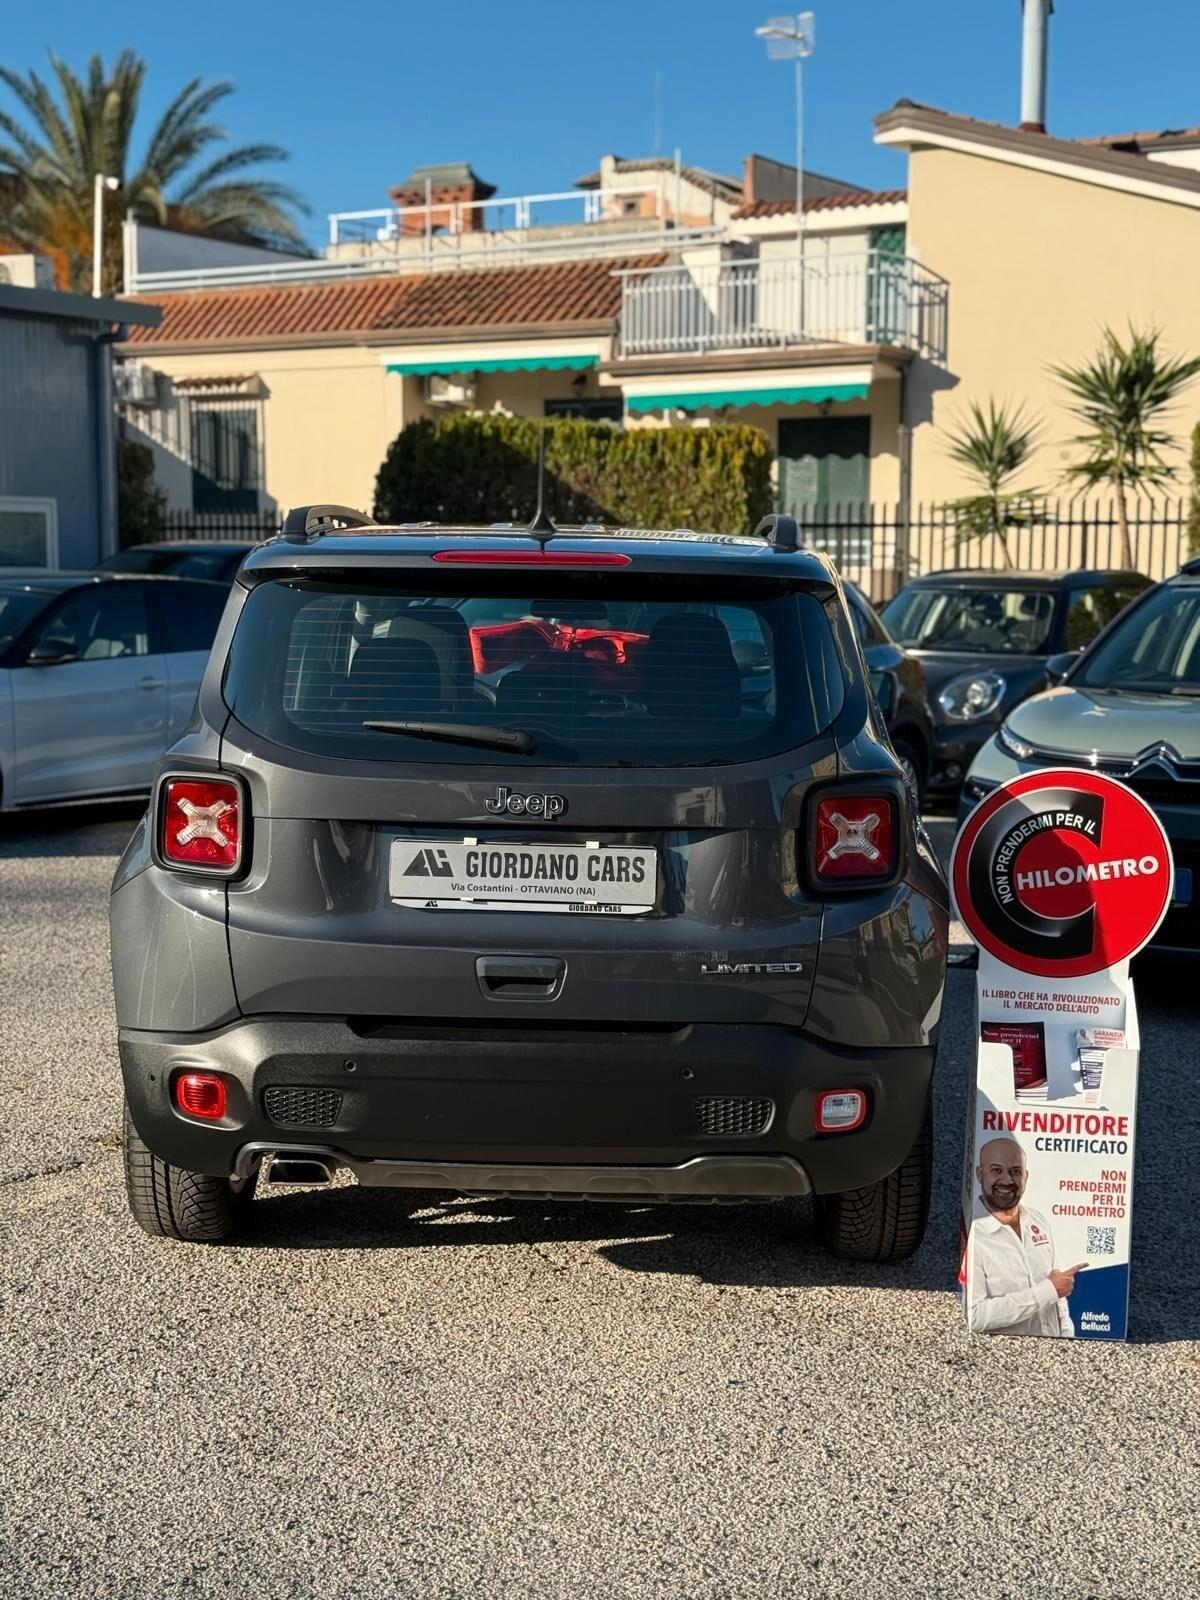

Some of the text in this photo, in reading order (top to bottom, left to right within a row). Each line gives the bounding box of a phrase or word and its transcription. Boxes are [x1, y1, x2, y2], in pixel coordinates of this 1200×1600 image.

[485, 787, 565, 819] Jeep
[996, 813, 1096, 904] NON PRENDERMI PER IL
[466, 851, 578, 881] GIORDANO
[588, 856, 645, 883] CARS
[467, 883, 513, 893] Costantini
[521, 885, 574, 894] OTTAVIANO
[576, 886, 596, 896] (NA)
[702, 963, 802, 974] LIMITED
[991, 990, 1016, 999] LIBRO
[1018, 992, 1035, 1000] CHE
[1037, 993, 1048, 1001] HA
[1053, 994, 1120, 1006] RIVOLUZIONATO
[1015, 1001, 1054, 1011] MERCATO
[983, 1110, 1128, 1136] RIVENDITORE
[1035, 1137, 1127, 1155] CERTIFICATO
[1101, 1170, 1126, 1181] NON
[1059, 1181, 1126, 1193] PRENDERMI
[1093, 1195, 1126, 1206] PER IL
[1052, 1205, 1125, 1218] CHILOMETRO
[1081, 1311, 1109, 1321] Alfredo
[1081, 1322, 1110, 1331] Bellucci
